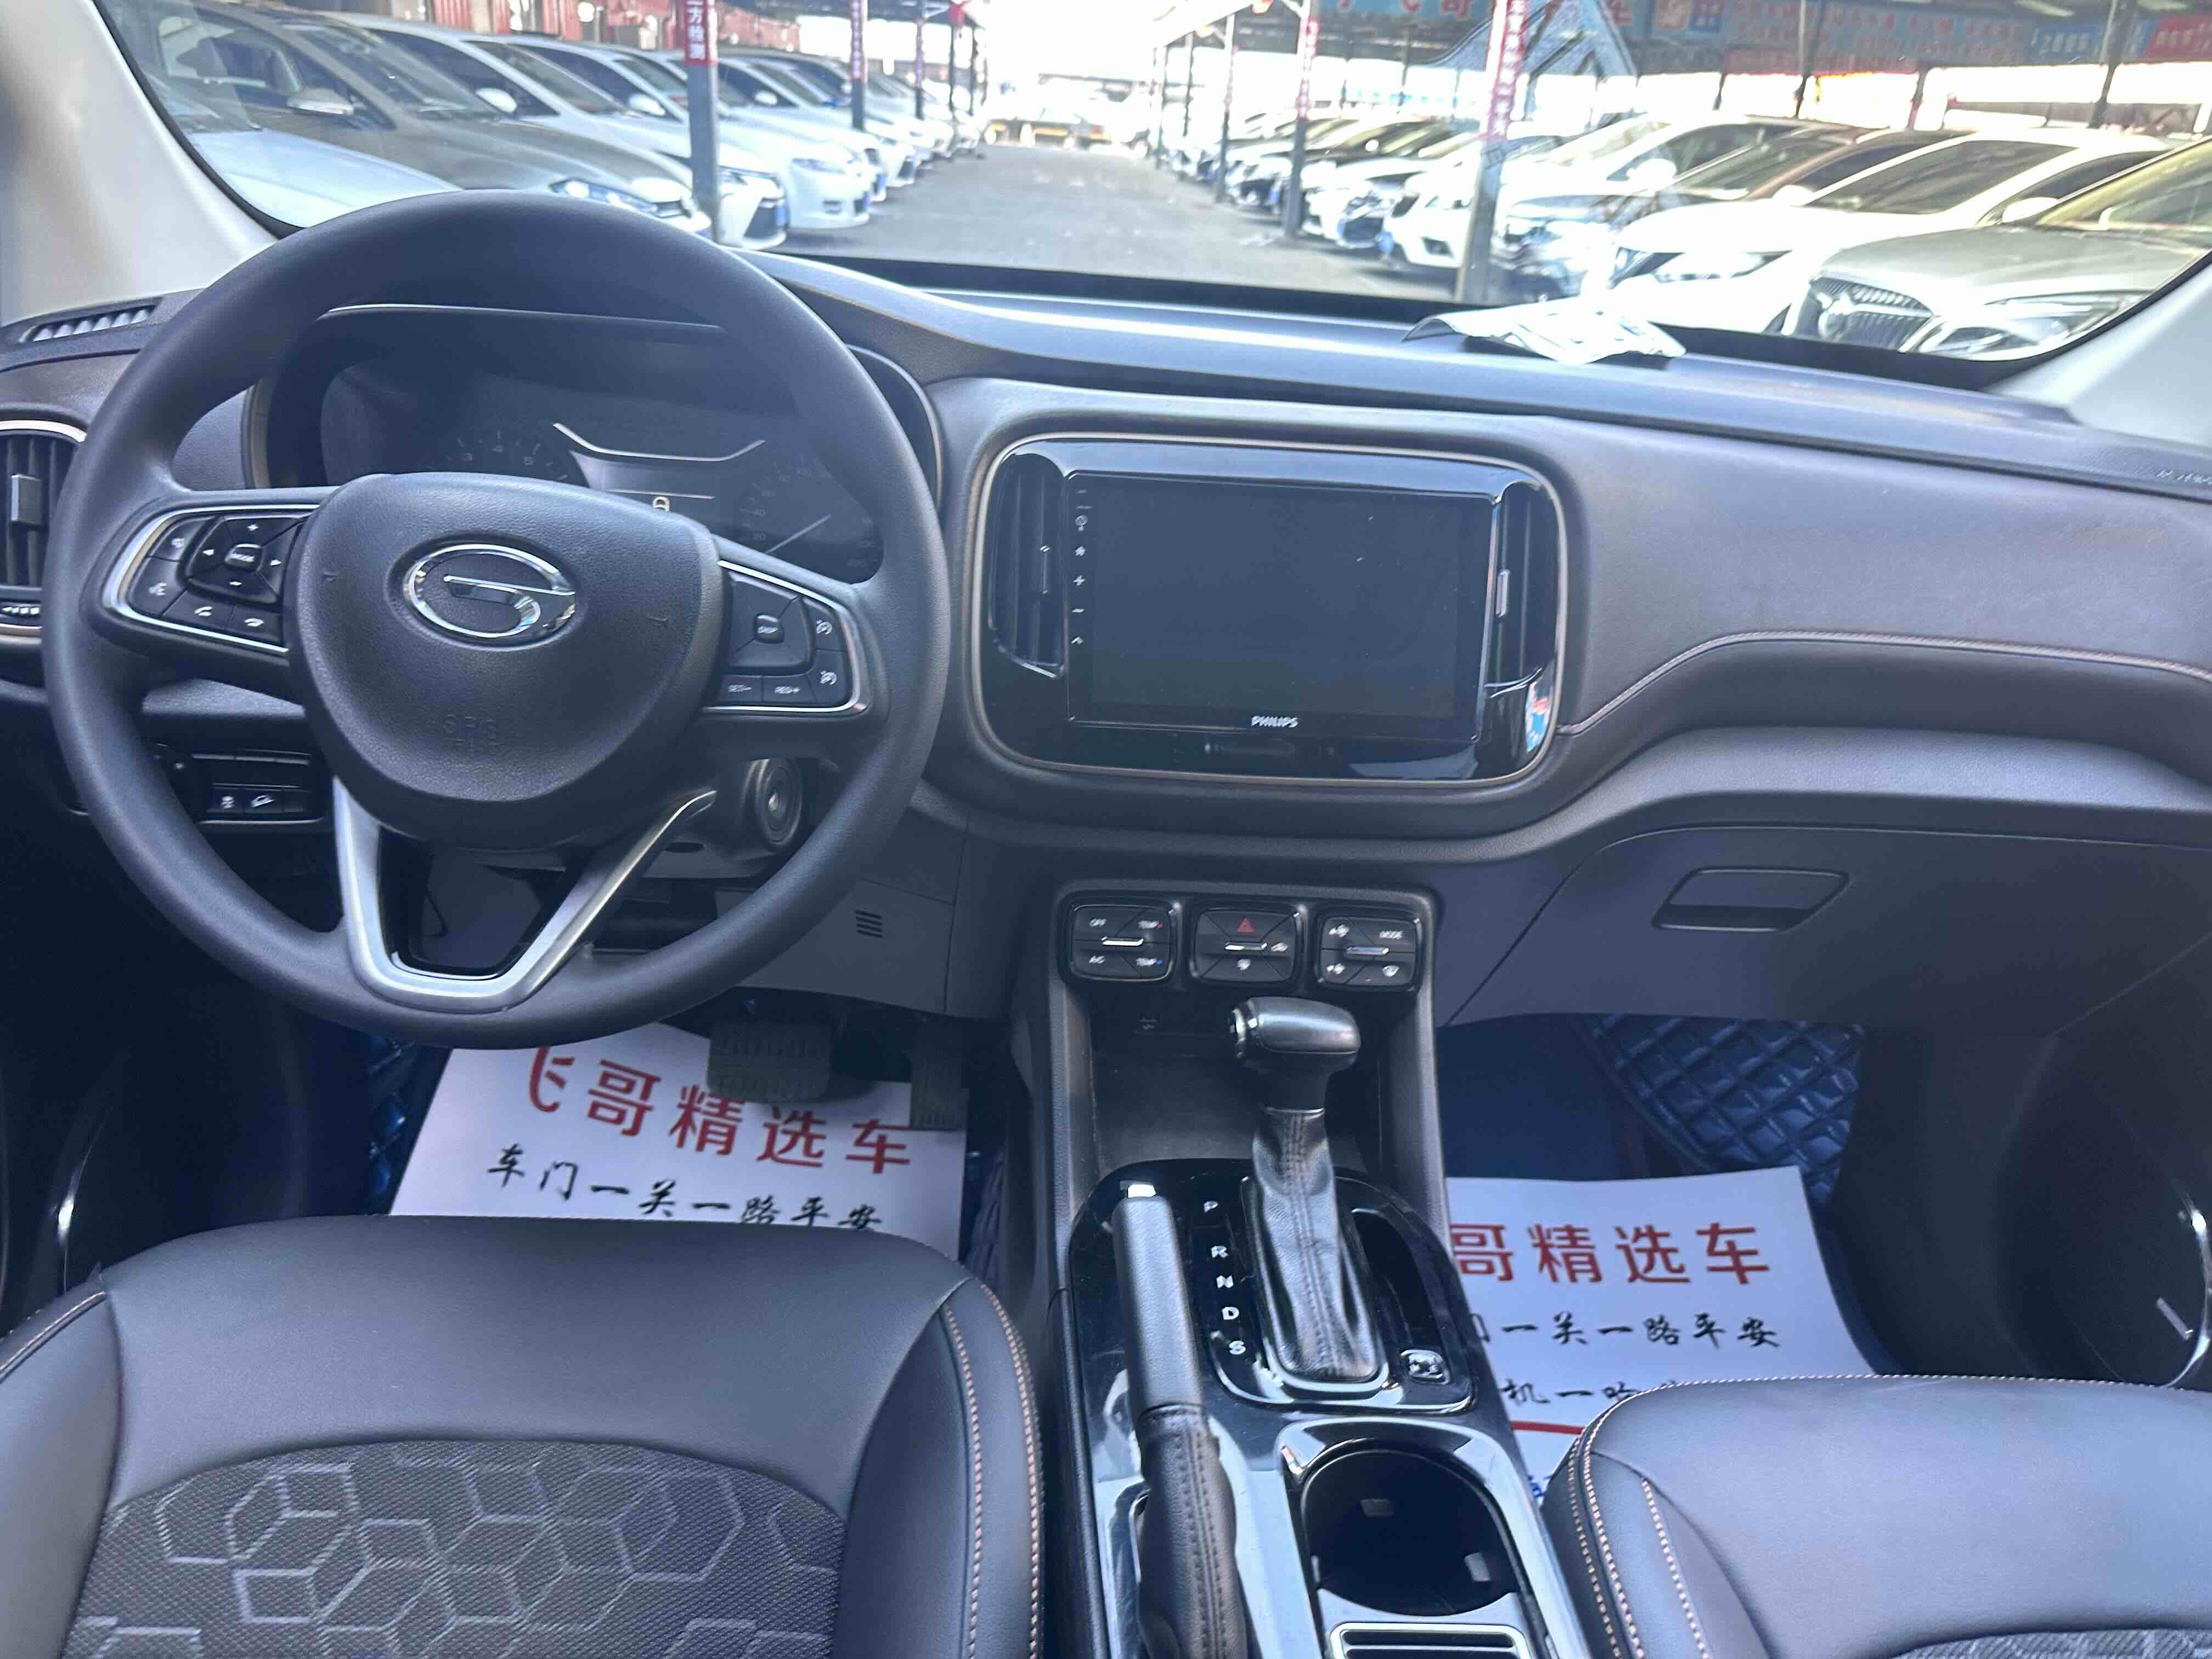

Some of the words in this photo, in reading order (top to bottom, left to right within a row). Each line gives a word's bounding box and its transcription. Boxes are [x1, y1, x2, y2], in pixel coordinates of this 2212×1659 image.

[1251, 715, 1299, 728] PHILIPS
[488, 1143, 882, 1231] 车门一关一路平安
[1204, 1200, 1218, 1212] P
[1211, 1245, 1228, 1258] R
[1449, 1223, 1770, 1285] 哥精选车
[1216, 1275, 1234, 1288] N
[1223, 1306, 1240, 1321] D
[1228, 1340, 1246, 1355] S
